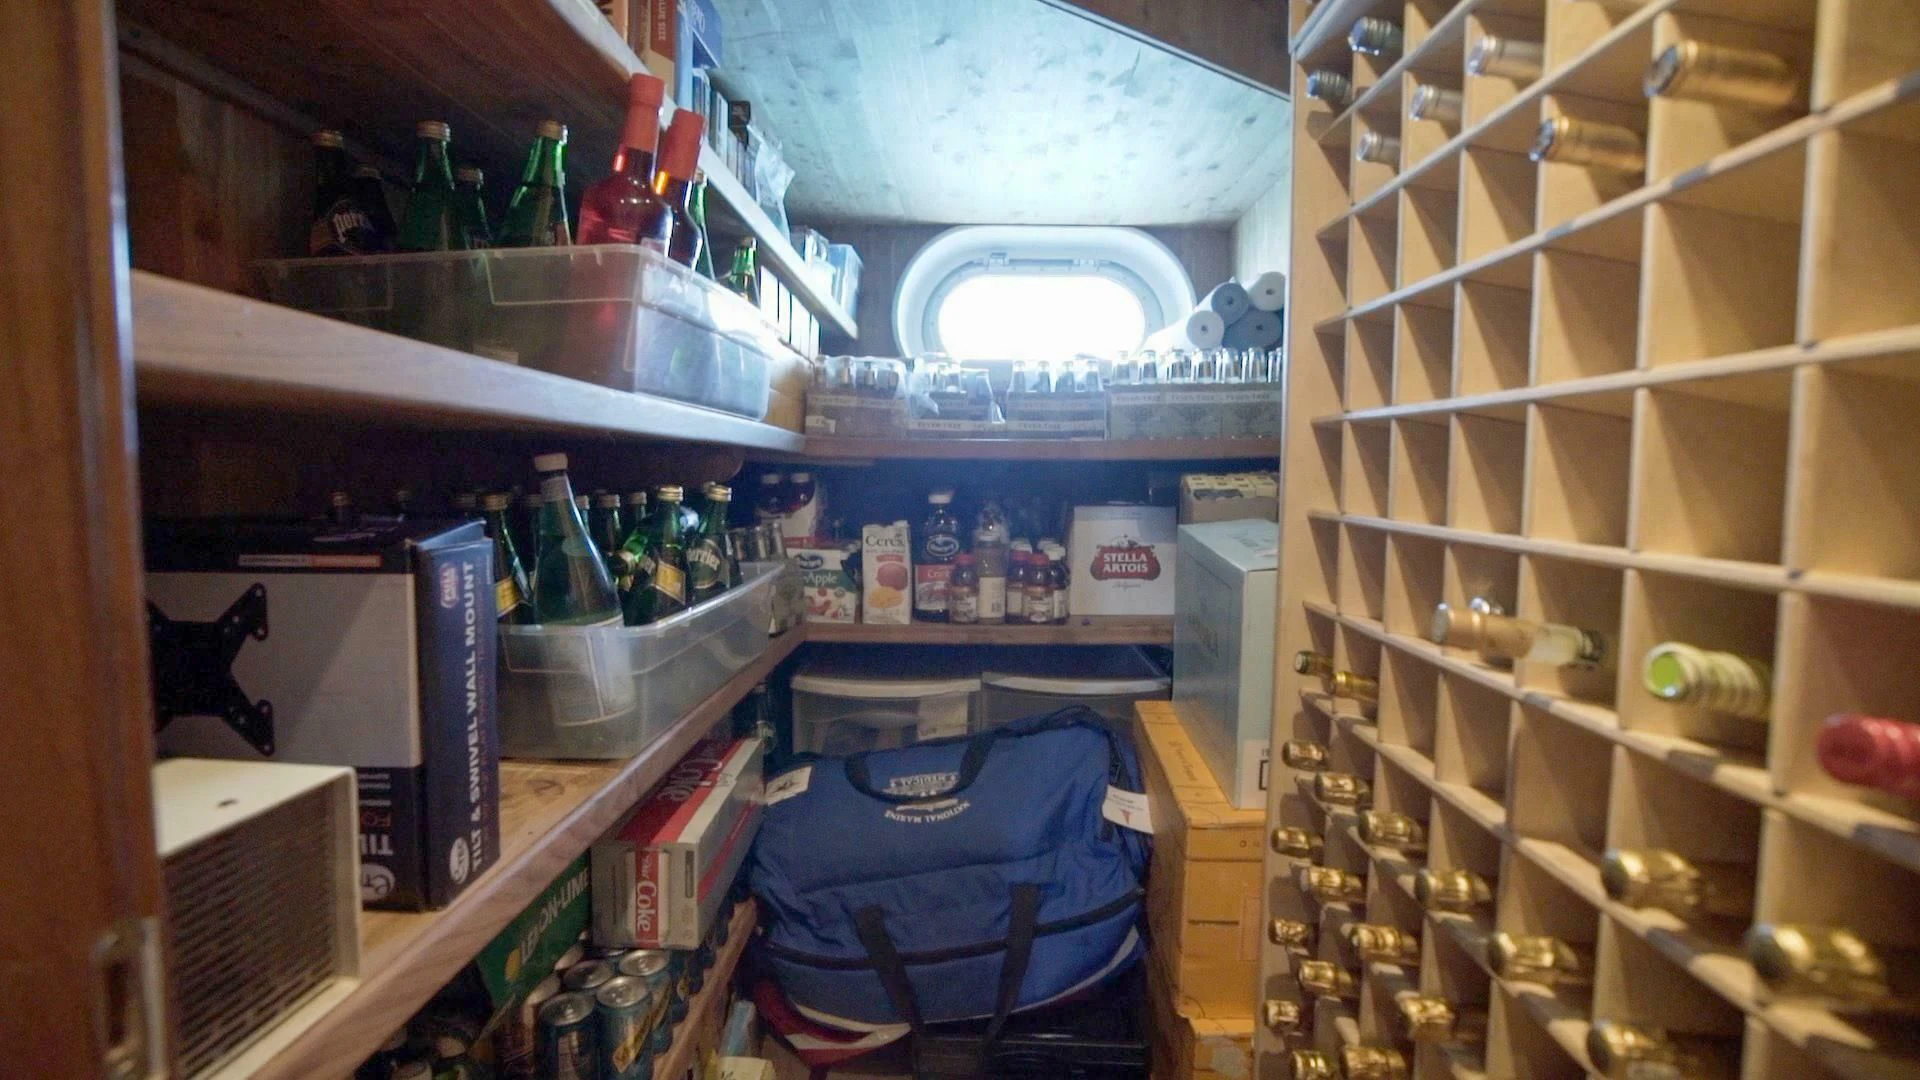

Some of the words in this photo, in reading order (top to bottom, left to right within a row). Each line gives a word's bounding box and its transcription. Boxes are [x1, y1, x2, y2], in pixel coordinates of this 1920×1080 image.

[1103, 552, 1148, 562] STELLA
[1103, 563, 1148, 573] ARTOIS
[463, 562, 475, 647] MOUNT
[465, 651, 477, 714] WALL
[467, 716, 480, 803] SWIVEL
[470, 805, 481, 821] &
[470, 829, 482, 872] TILT
[636, 881, 657, 932] Coke
